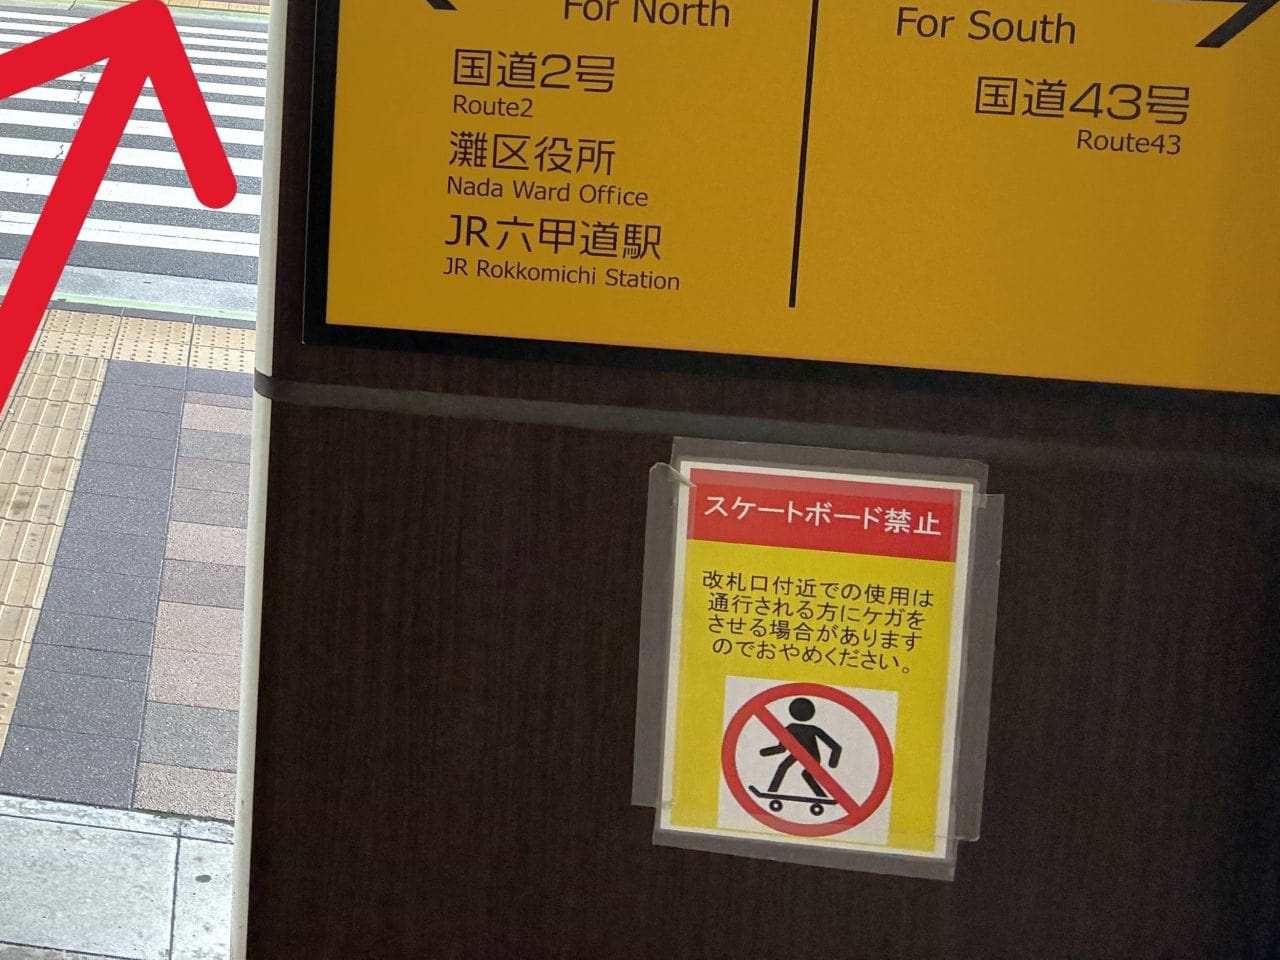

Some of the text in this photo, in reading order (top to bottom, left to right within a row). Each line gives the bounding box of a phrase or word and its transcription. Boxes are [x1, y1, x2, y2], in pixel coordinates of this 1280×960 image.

[896, 7, 1076, 45] For South
[454, 49, 615, 93] 国道2号
[453, 95, 533, 118] Route2
[975, 77, 1190, 125] 国道43号
[449, 131, 616, 176] 灘区役所
[1077, 130, 1181, 156] Route43
[447, 176, 649, 207] Nada Ward Office
[444, 215, 662, 261] JR六甲道駅
[443, 257, 680, 291] JR Rokkomichi Station
[704, 496, 942, 536] スケートボード禁止
[703, 571, 934, 608] 改札口付近での使用は
[708, 592, 925, 630] 通行される方にケガを
[708, 614, 922, 651] させる場合があります
[712, 638, 911, 674] のでおやめください。
